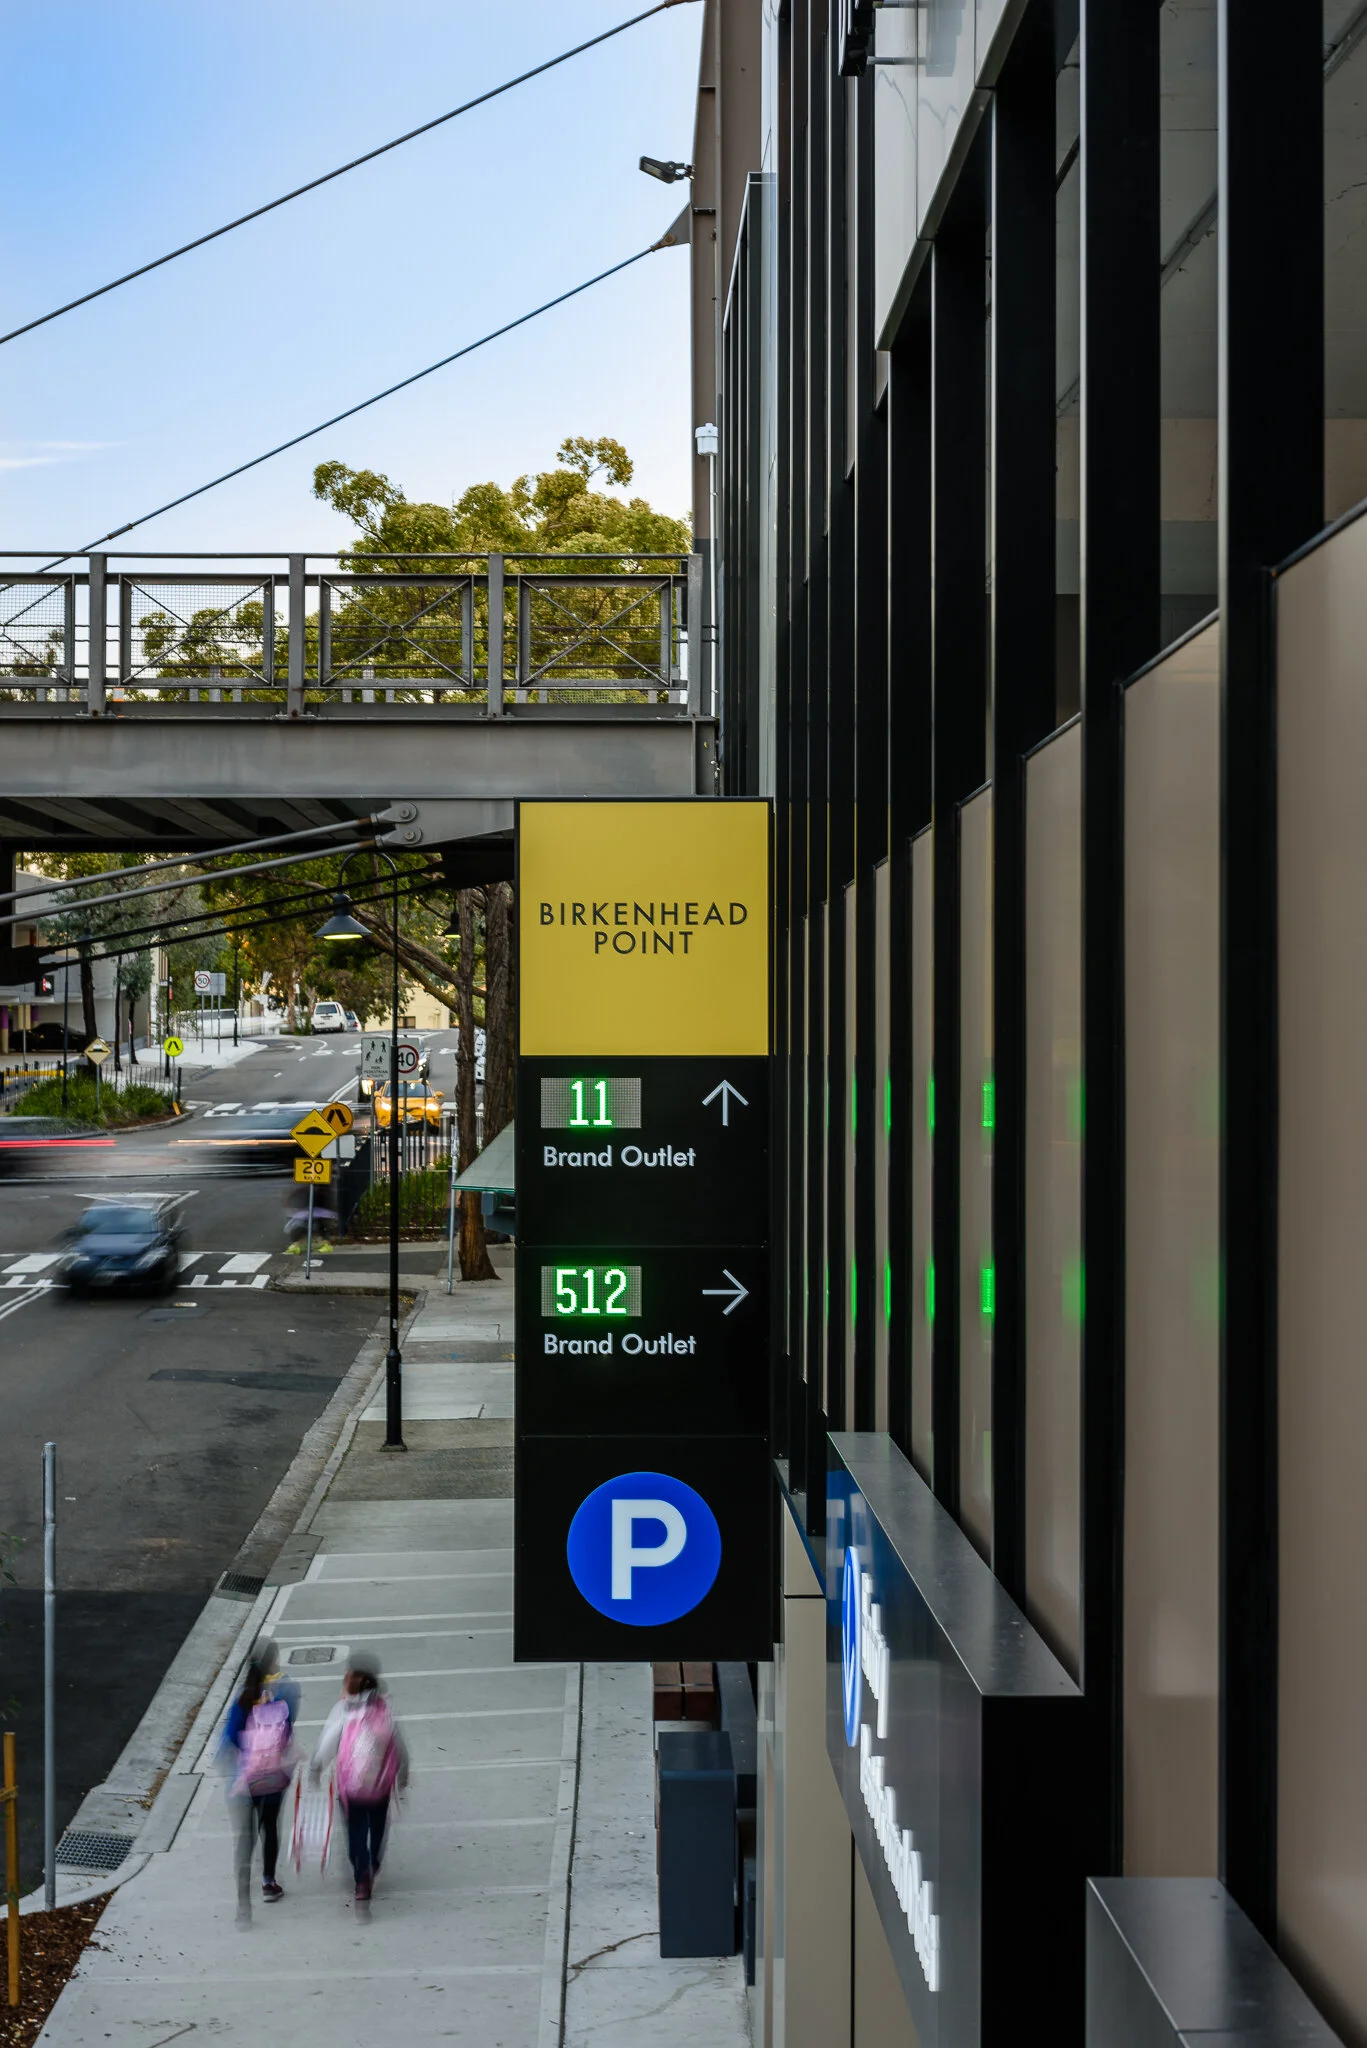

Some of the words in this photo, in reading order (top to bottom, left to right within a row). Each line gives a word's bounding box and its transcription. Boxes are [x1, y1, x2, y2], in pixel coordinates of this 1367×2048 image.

[540, 902, 748, 926] BIRKENHEAD
[594, 931, 693, 954] POINT
[398, 1052, 415, 1067] 40
[569, 1080, 613, 1126] 11
[543, 1145, 613, 1167] Brand
[620, 1145, 697, 1167] Outlet
[302, 1161, 324, 1175] 20
[556, 1268, 627, 1314] 512
[544, 1332, 613, 1355] Brand
[621, 1332, 697, 1355] Outlet
[611, 1499, 688, 1600] P
